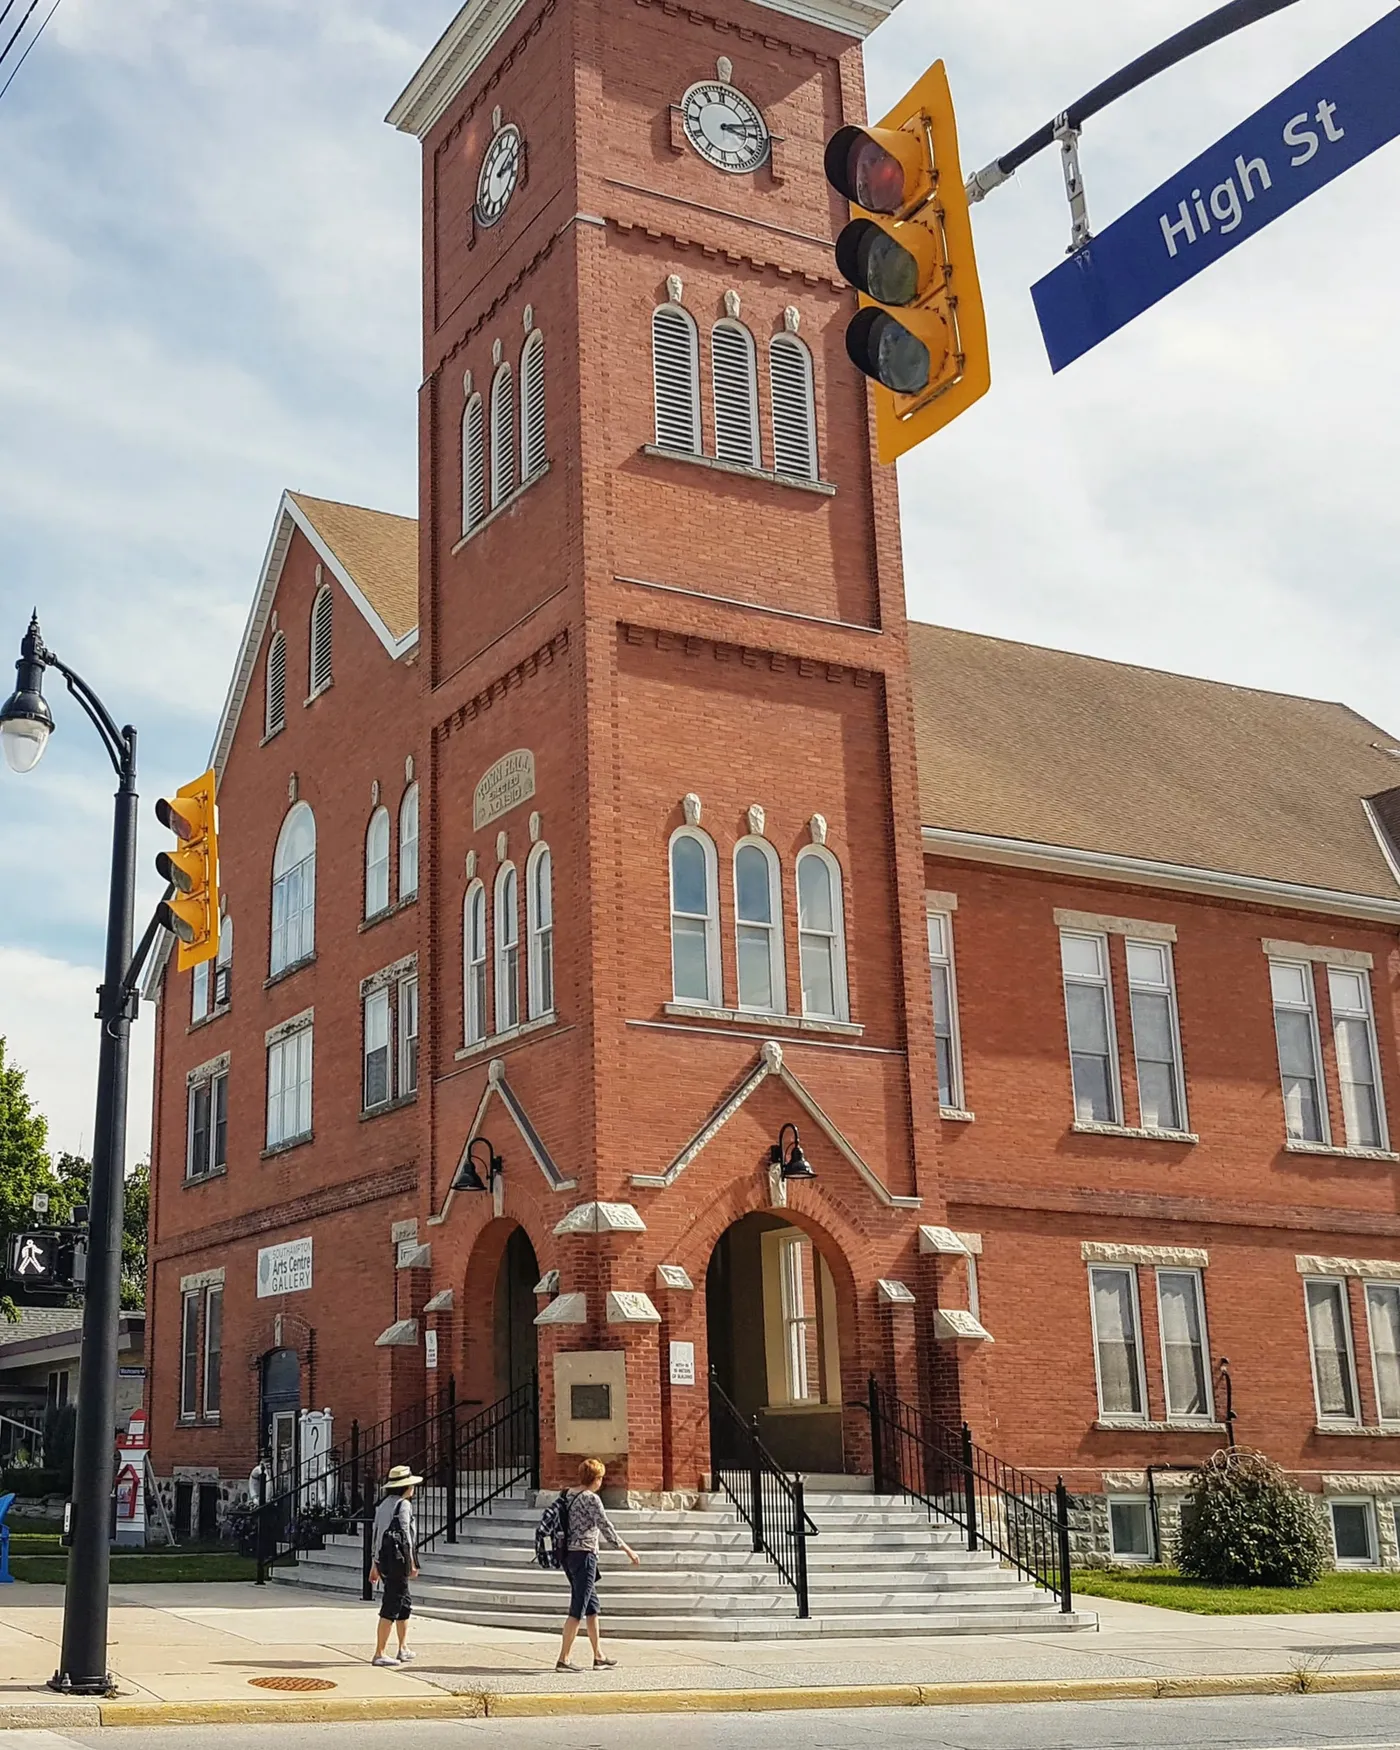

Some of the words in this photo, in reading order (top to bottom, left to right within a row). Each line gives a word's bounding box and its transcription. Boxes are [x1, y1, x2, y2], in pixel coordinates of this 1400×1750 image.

[1158, 154, 1272, 258] High
[1282, 99, 1345, 167] St
[272, 1241, 311, 1260] SOUTHAMPTON
[272, 1259, 288, 1276] Arts
[289, 1255, 310, 1273] Centre
[271, 1270, 311, 1292] GALLERY
